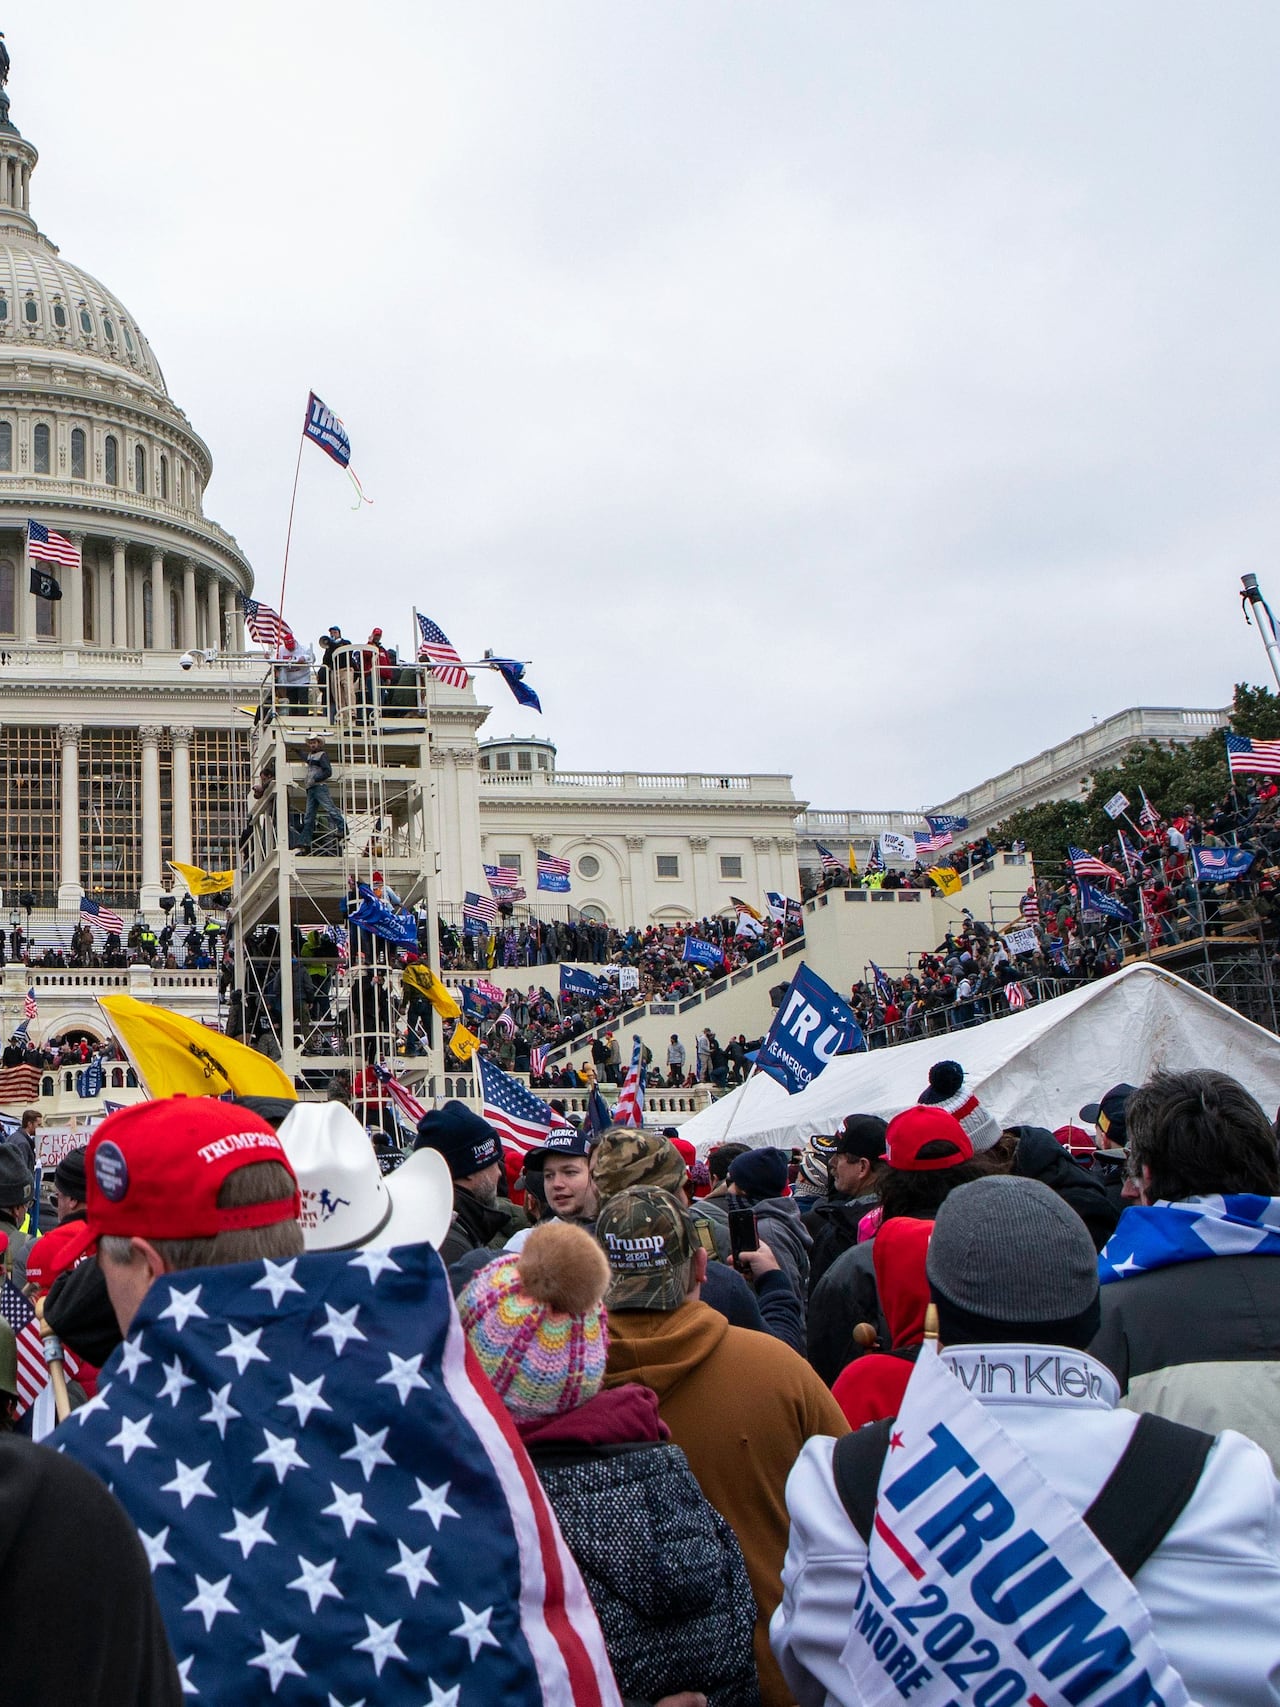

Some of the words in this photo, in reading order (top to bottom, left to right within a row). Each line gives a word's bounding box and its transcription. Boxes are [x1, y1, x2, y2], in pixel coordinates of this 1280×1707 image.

[691, 940, 721, 956] TRUMP
[565, 983, 596, 996] LIBERTY
[777, 1047, 813, 1083] AMERICA
[549, 1128, 578, 1138] AMERICA
[472, 1138, 496, 1155] Trump
[550, 1138, 573, 1146] AGAIN
[605, 1233, 665, 1254] Trump
[625, 1252, 650, 1261] 2020
[1025, 1355, 1102, 1400] Klein
[856, 1600, 933, 1700] MORE
[891, 1584, 1027, 1707] 2020
